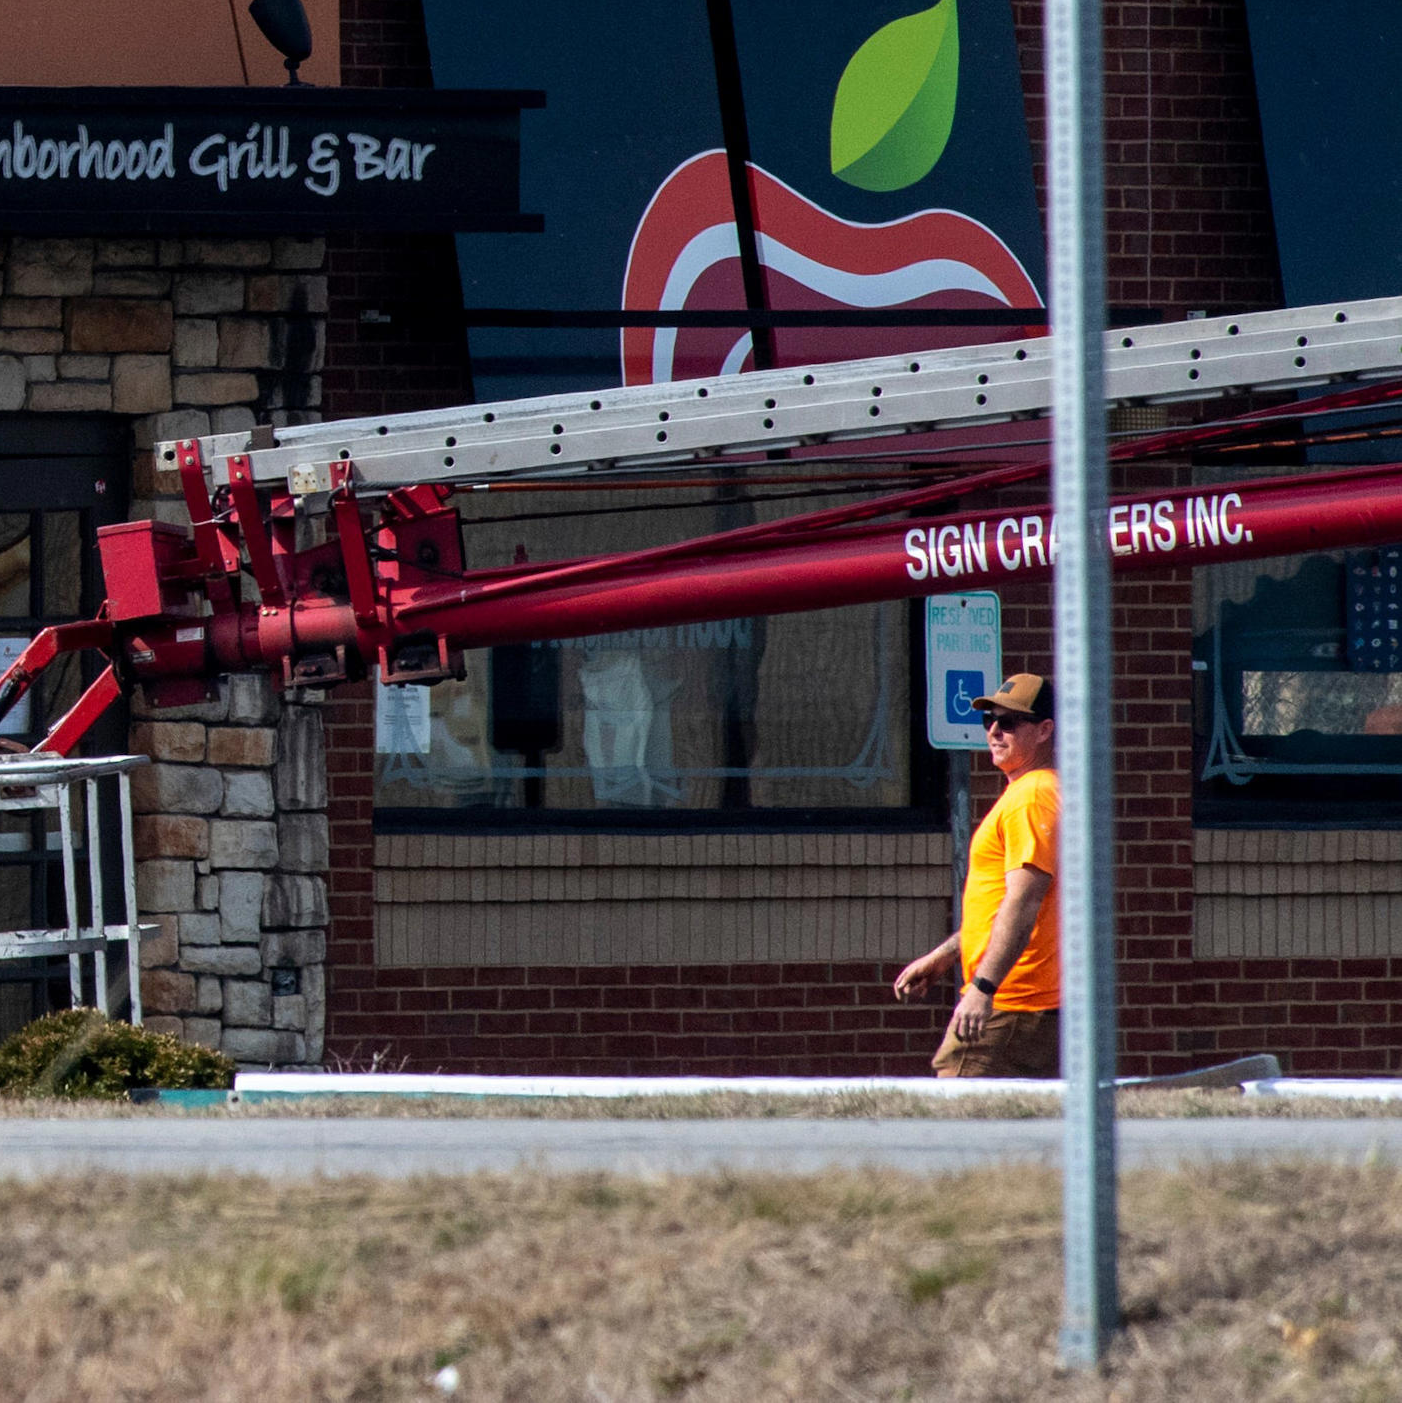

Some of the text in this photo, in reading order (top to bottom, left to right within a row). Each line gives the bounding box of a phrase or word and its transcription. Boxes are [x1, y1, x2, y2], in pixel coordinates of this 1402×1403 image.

[188, 122, 298, 192] Grill
[304, 131, 341, 197] &
[348, 132, 436, 181] Bar
[903, 520, 990, 582] SIGN
[1184, 492, 1255, 550] INC.
